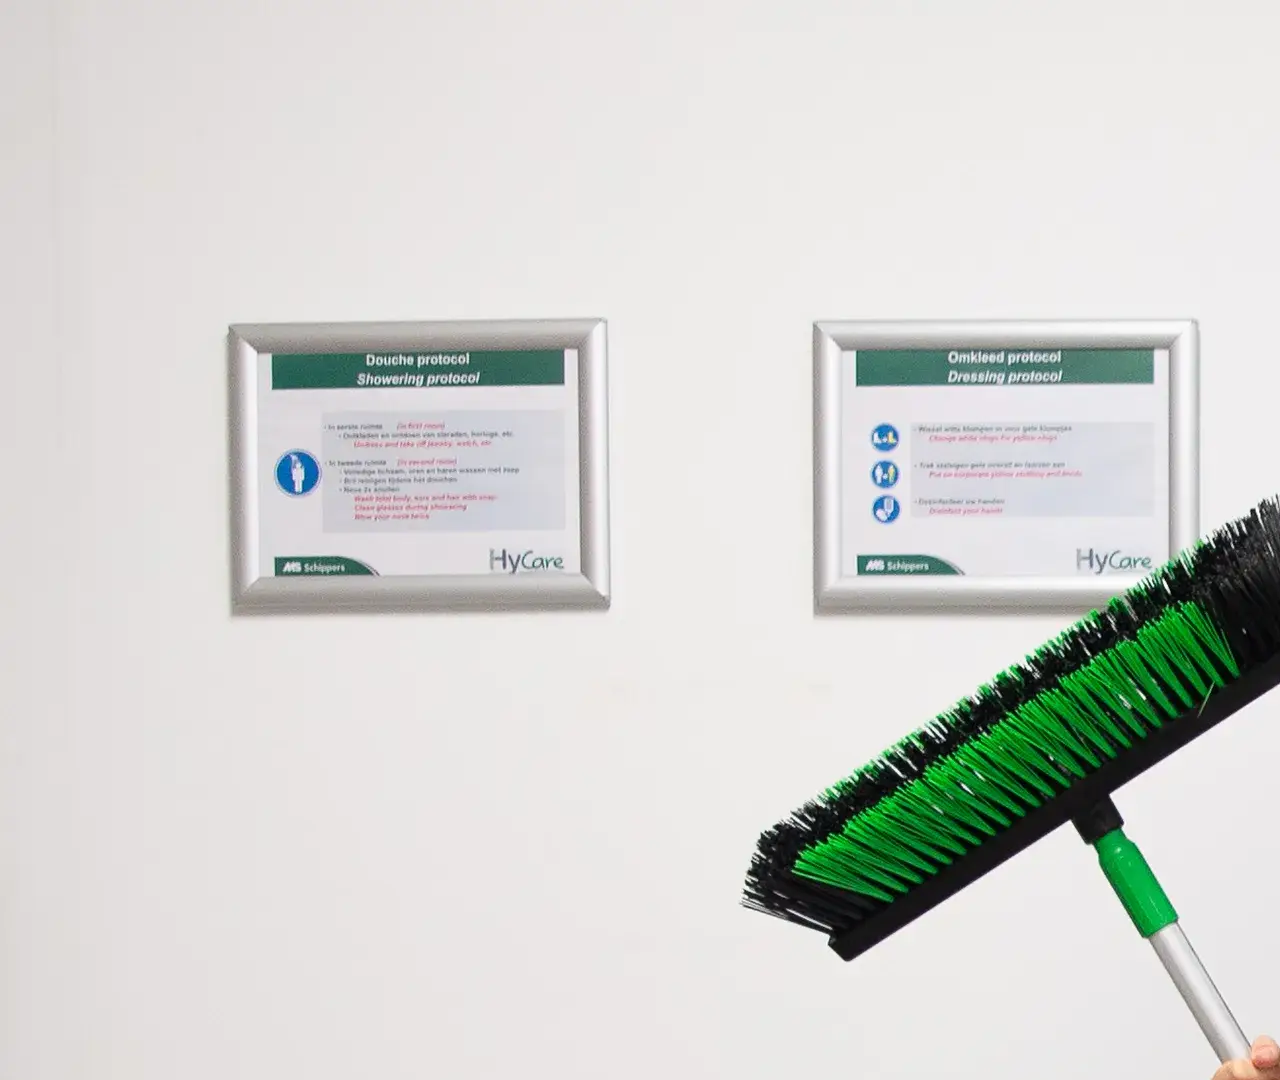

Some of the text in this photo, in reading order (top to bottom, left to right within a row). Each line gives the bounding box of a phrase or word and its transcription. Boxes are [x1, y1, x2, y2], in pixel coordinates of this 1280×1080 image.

[366, 353, 470, 368] Douche protocol
[948, 351, 1061, 366] Omkleed protocol
[357, 371, 480, 387] Showering protocol
[948, 369, 1062, 385] Dressing protocol
[304, 562, 345, 574] Schippers
[489, 548, 565, 575] HyCare
[887, 560, 929, 573] Schippers
[1076, 548, 1153, 575] HyCare
